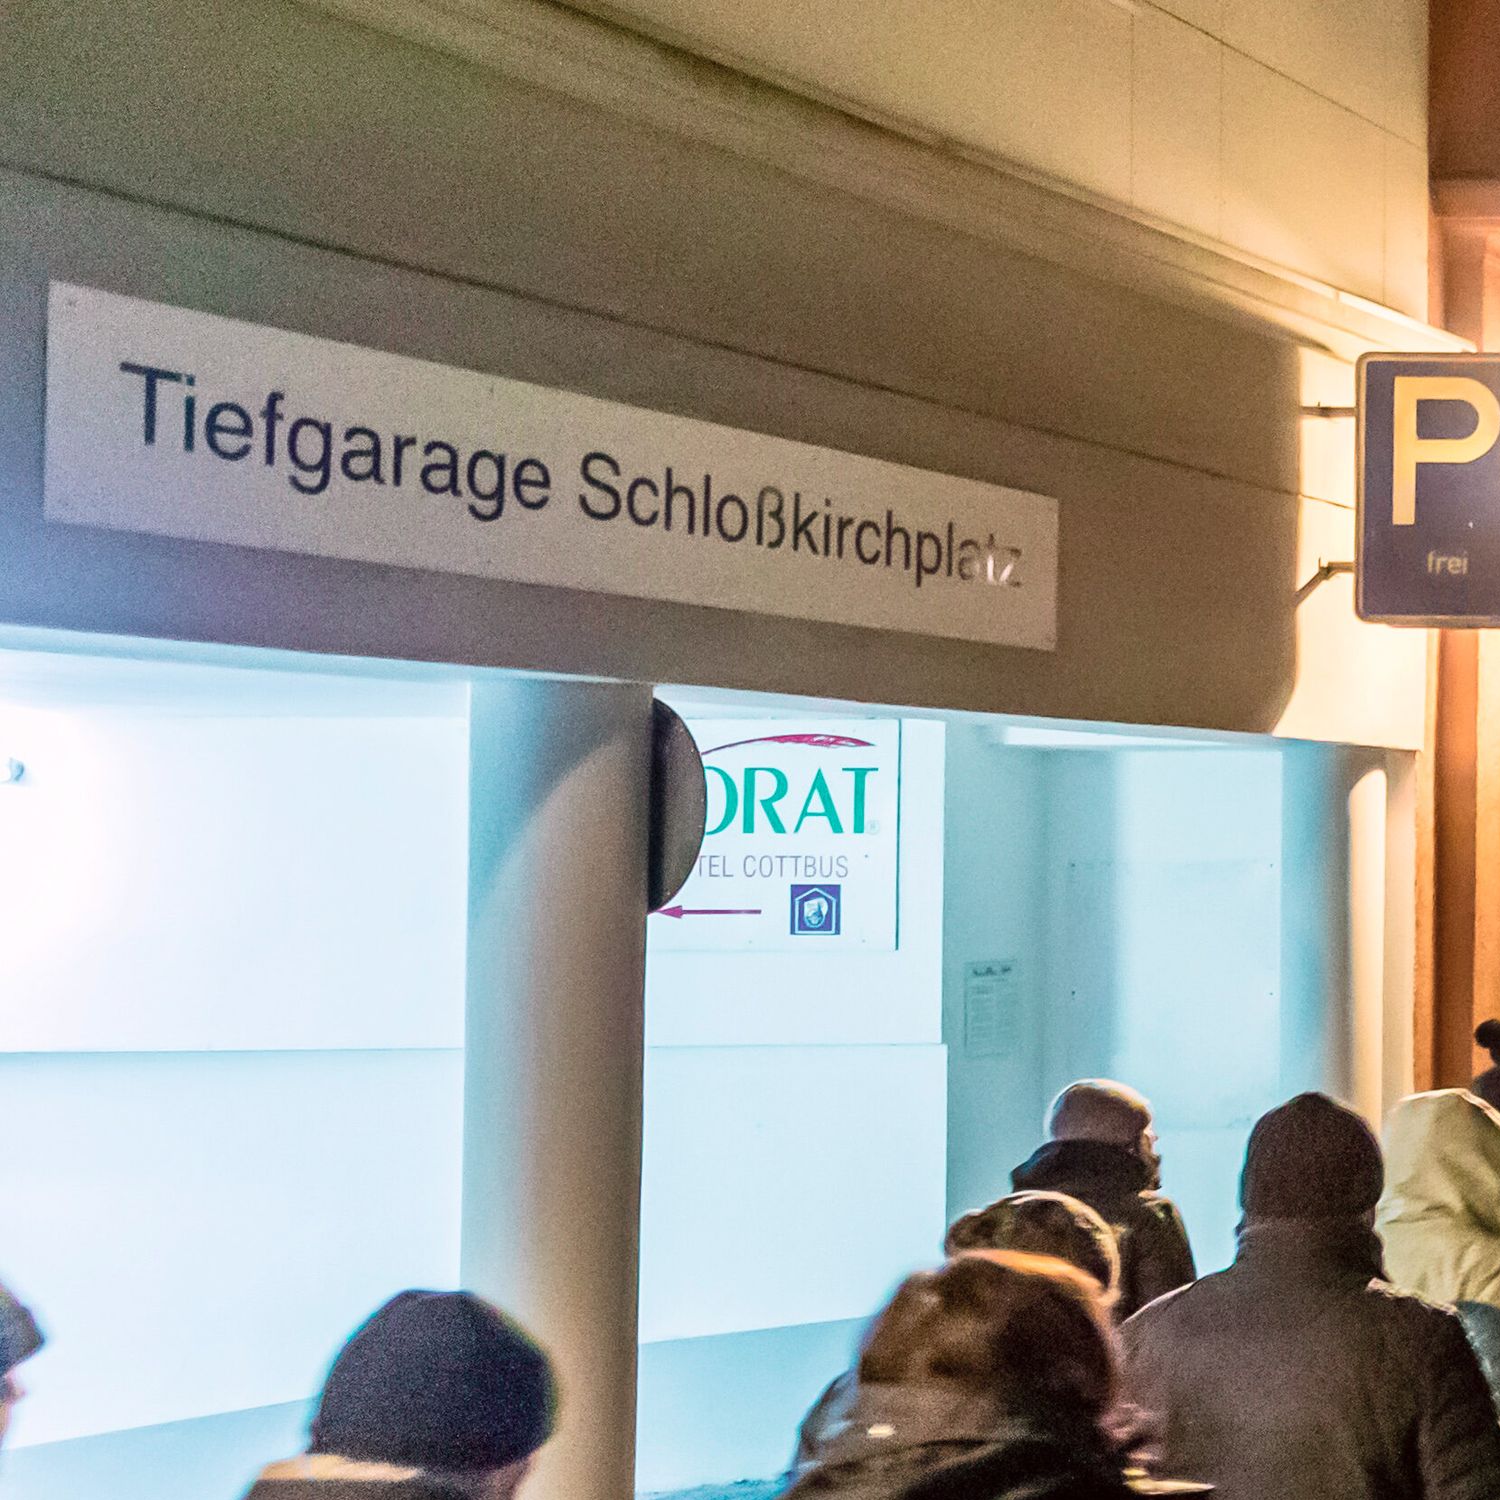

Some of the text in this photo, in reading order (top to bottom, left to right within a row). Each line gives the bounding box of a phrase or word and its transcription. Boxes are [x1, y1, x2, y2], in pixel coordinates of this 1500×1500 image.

[119, 361, 1023, 588] Tiefgarage Schloßkirchplatz
[1426, 551, 1468, 575] frei
[743, 855, 849, 878] COTTBUS
